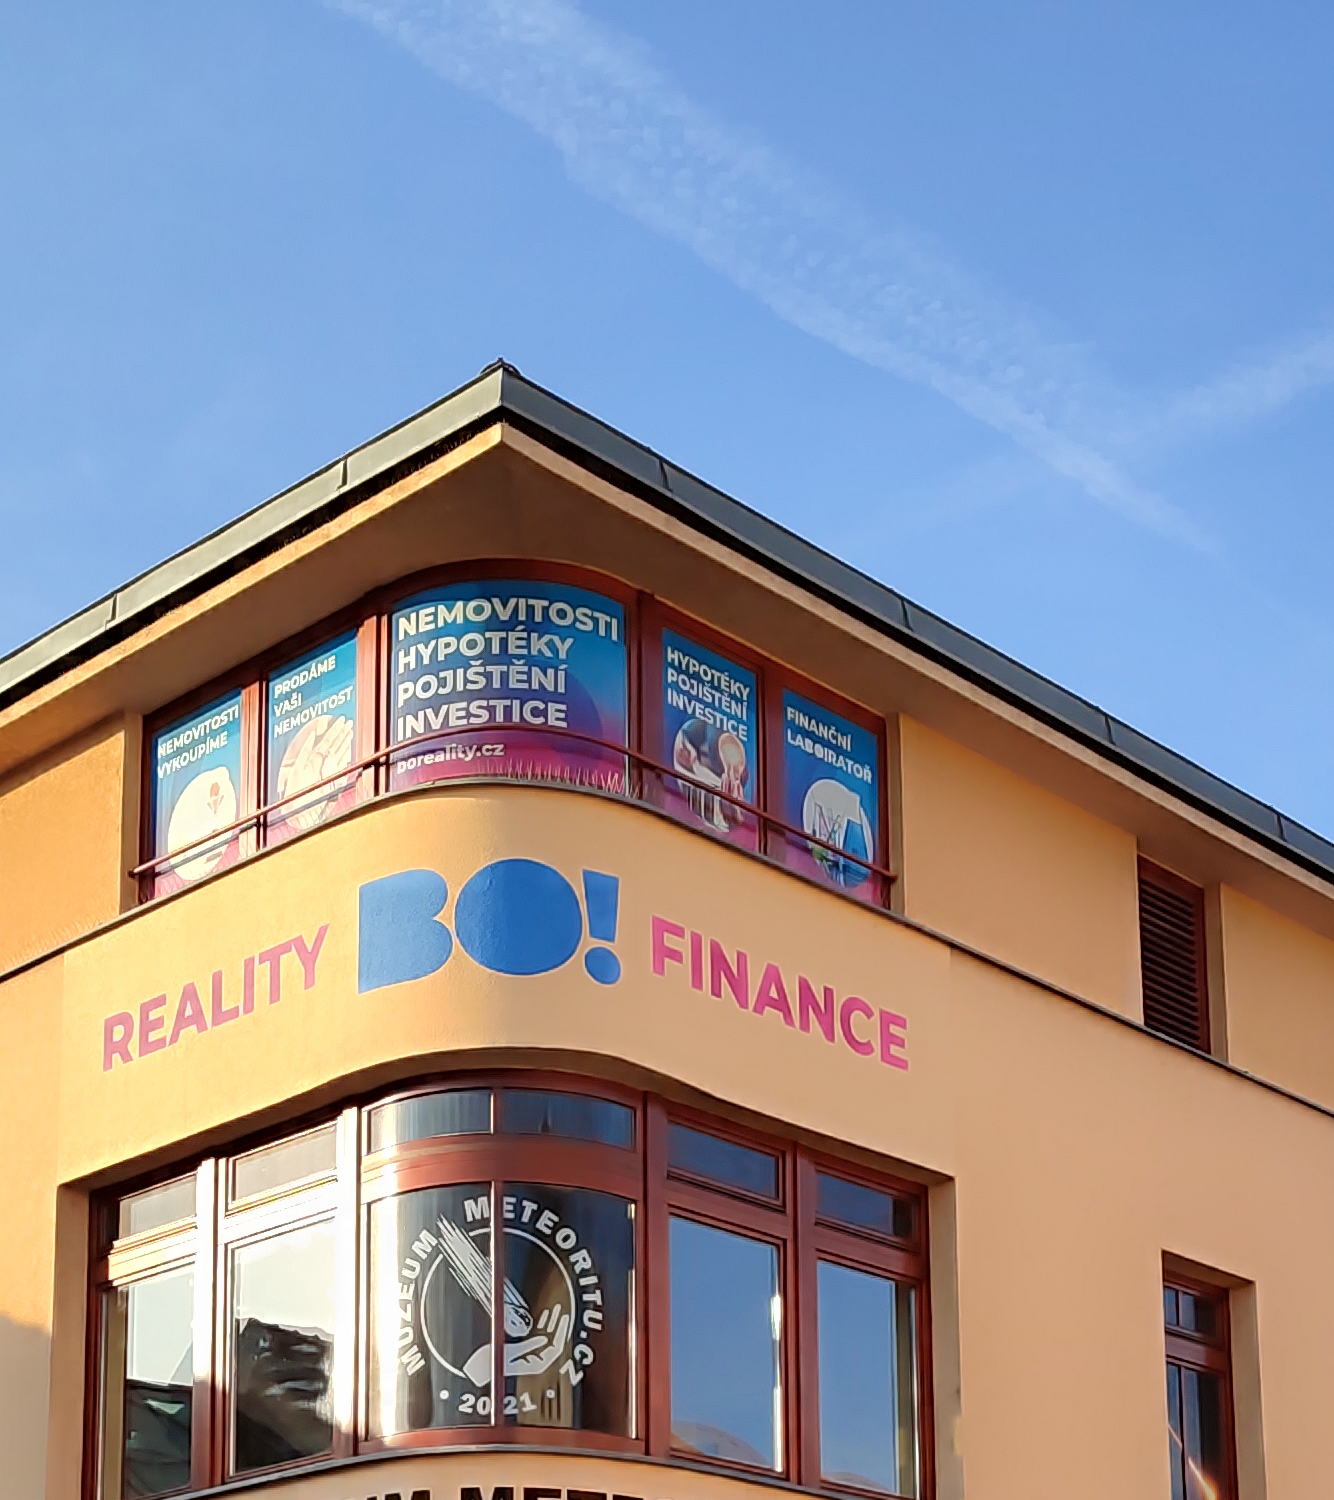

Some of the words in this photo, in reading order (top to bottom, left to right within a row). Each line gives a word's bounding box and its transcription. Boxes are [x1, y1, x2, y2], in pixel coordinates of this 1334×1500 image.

[398, 596, 619, 642] NEMOVITOSTI
[398, 626, 574, 673] HYPOTÉKY
[667, 646, 750, 700] HYPOTÉKY
[274, 654, 336, 698] PRODÁME
[397, 663, 567, 707] POJIŠTĚNÍ
[667, 668, 748, 721] POJIŠTĚNÍ
[273, 686, 354, 739] NEMOVITOST
[274, 691, 302, 717] VAŠI
[397, 698, 567, 742] INVESTICE
[667, 688, 748, 742] INVESTICE
[158, 704, 239, 759] NEMOVITOSTI
[787, 706, 852, 752] FINANČNÍ
[158, 731, 228, 778] VYKOUPÍME
[102, 924, 329, 1072] REALITY
[358, 857, 620, 995] BO!
[650, 915, 910, 1070] FINANCE
[397, 1229, 437, 1376] MUZEUM
[458, 1391, 537, 1416] 2021
